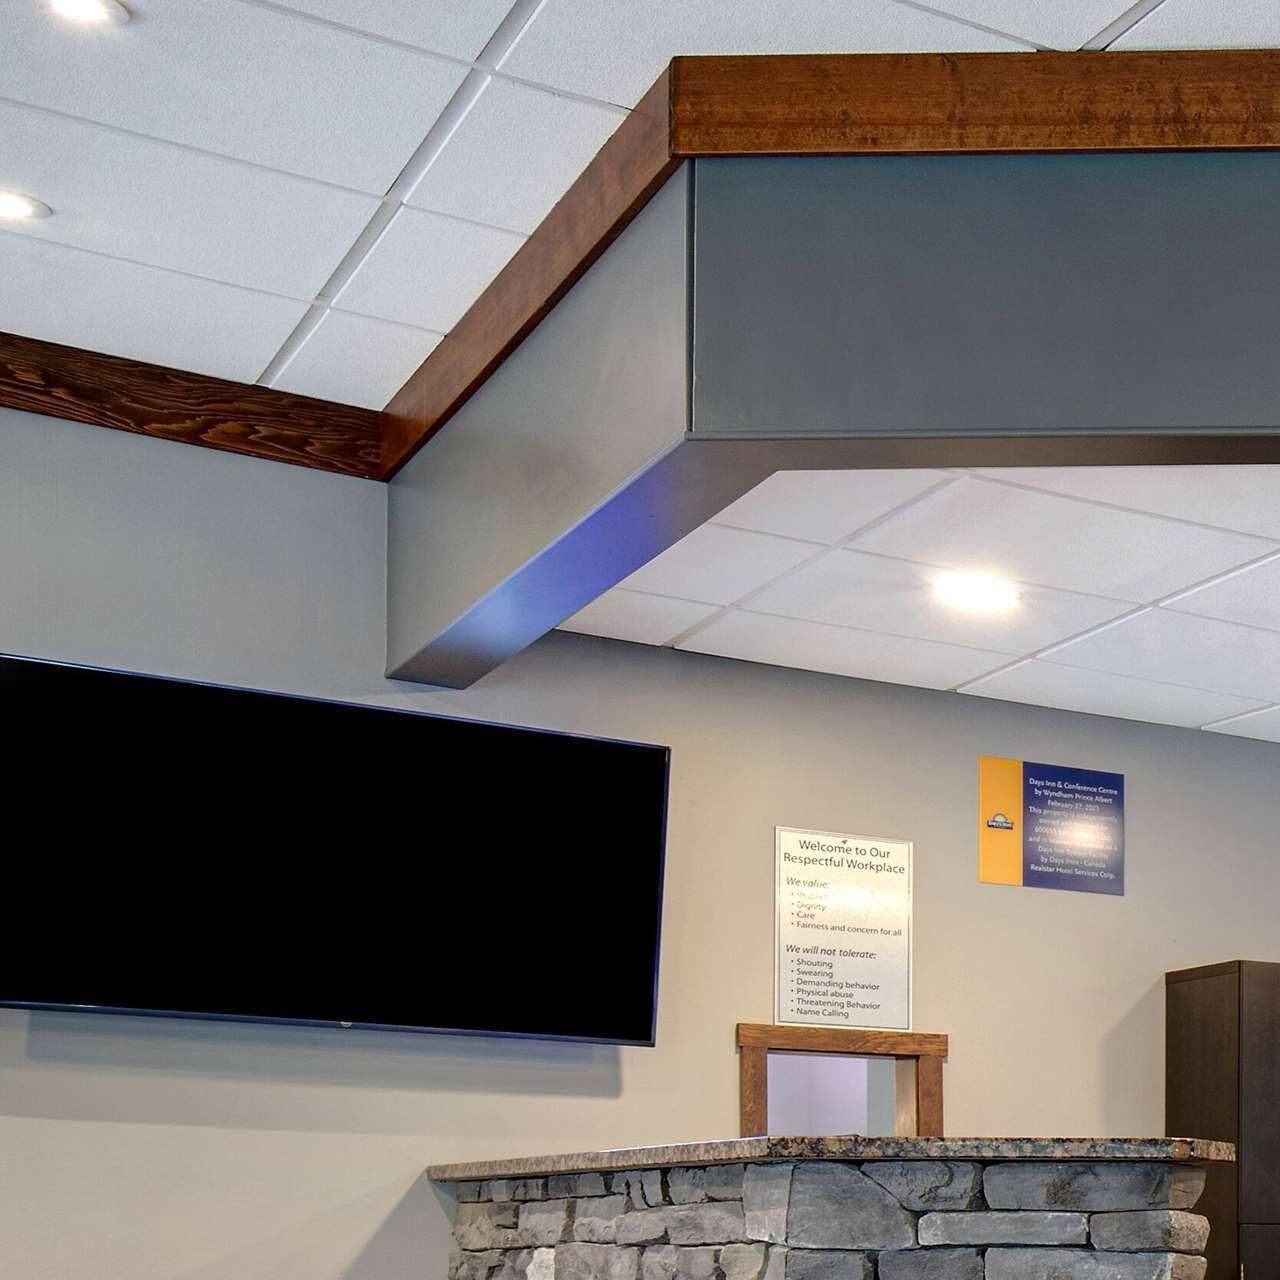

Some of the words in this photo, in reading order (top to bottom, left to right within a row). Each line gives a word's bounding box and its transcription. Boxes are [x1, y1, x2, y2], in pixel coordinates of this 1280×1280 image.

[1028, 778, 1045, 787] Days
[1043, 789, 1074, 799] Wyndham
[799, 840, 852, 854] Welcome
[855, 847, 867, 856] to
[869, 847, 891, 858] Our
[783, 852, 844, 868] Respectful
[846, 859, 905, 874] Workplace
[786, 877, 801, 886] We
[796, 911, 815, 920] Care
[796, 921, 829, 931] Fairness
[847, 926, 879, 935] concern
[880, 928, 891, 936] for
[786, 944, 801, 953] We
[802, 946, 819, 954] will
[820, 948, 837, 956] not
[839, 949, 877, 960] tolerate:
[796, 958, 833, 969] Shouting
[796, 968, 834, 978] Swearing
[796, 978, 843, 989] Demanding
[845, 982, 880, 990] behavior
[796, 988, 828, 998] Physical
[830, 991, 854, 999] abuse
[796, 998, 845, 1009] Threatening
[846, 1001, 881, 1010] Behavior
[796, 1008, 820, 1016] Name
[822, 1008, 849, 1019] Calling
